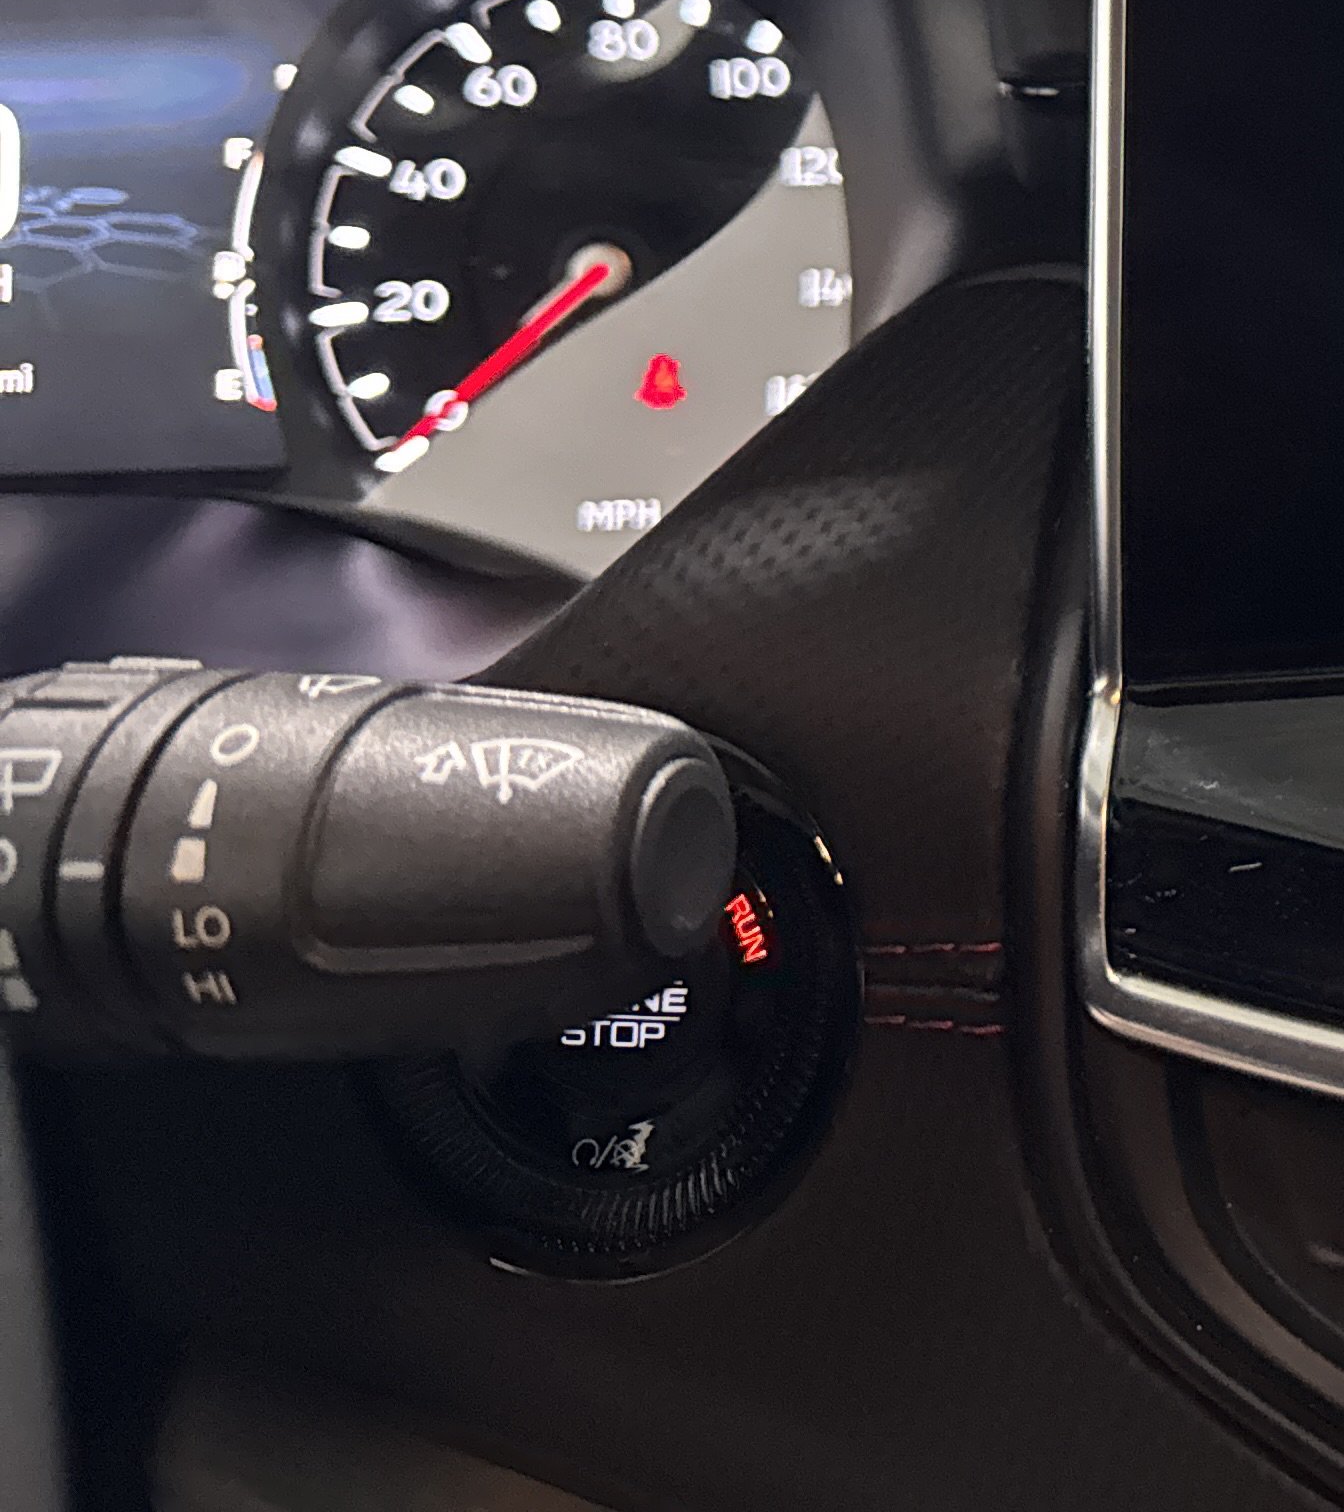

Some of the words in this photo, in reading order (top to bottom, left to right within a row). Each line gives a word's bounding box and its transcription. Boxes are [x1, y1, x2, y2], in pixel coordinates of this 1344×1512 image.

[587, 19, 660, 62] 80
[462, 65, 538, 108] 60
[709, 56, 792, 100] 100
[223, 137, 254, 170] F
[389, 157, 468, 201] 40
[372, 279, 450, 324] 20
[799, 267, 852, 307] 14
[214, 368, 245, 401] E
[577, 497, 661, 532] MPH
[171, 905, 232, 951] LO
[724, 892, 767, 965] RUN
[182, 968, 237, 1004] HI
